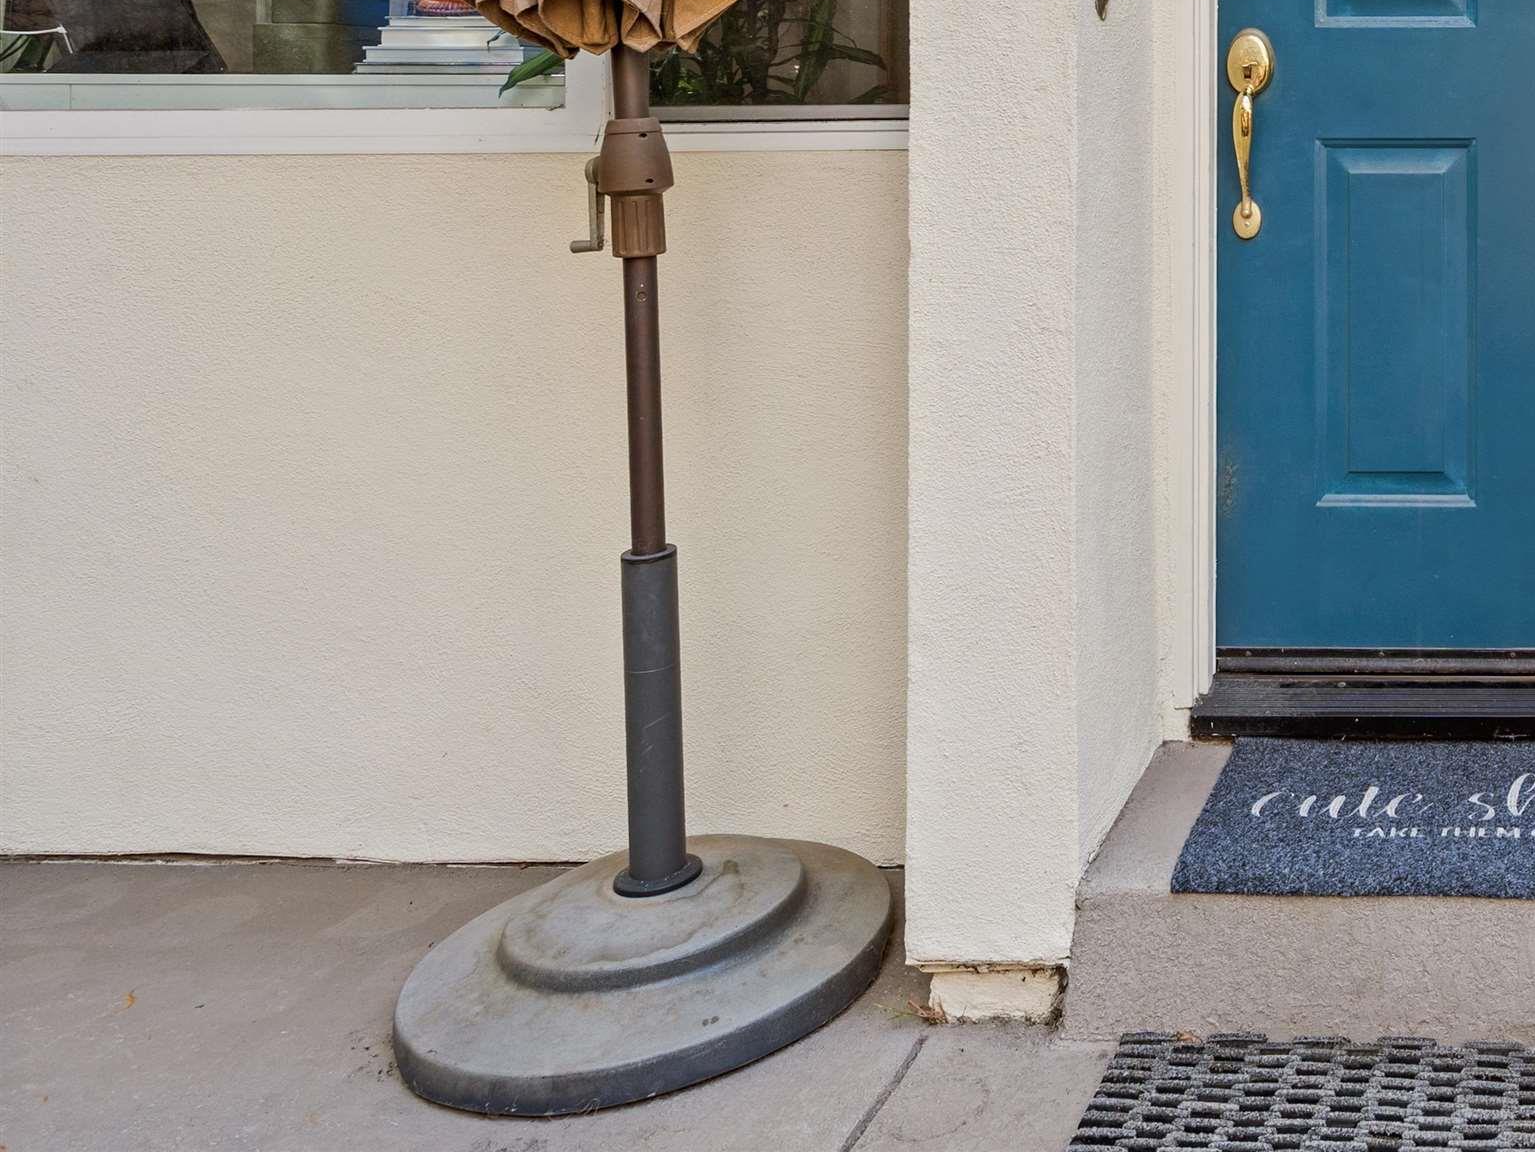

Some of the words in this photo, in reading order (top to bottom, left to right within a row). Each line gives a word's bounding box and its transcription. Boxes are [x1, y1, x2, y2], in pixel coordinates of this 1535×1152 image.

[1251, 786, 1433, 818] cute
[1353, 827, 1426, 838] TAKE
[1441, 826, 1521, 839] THEM
